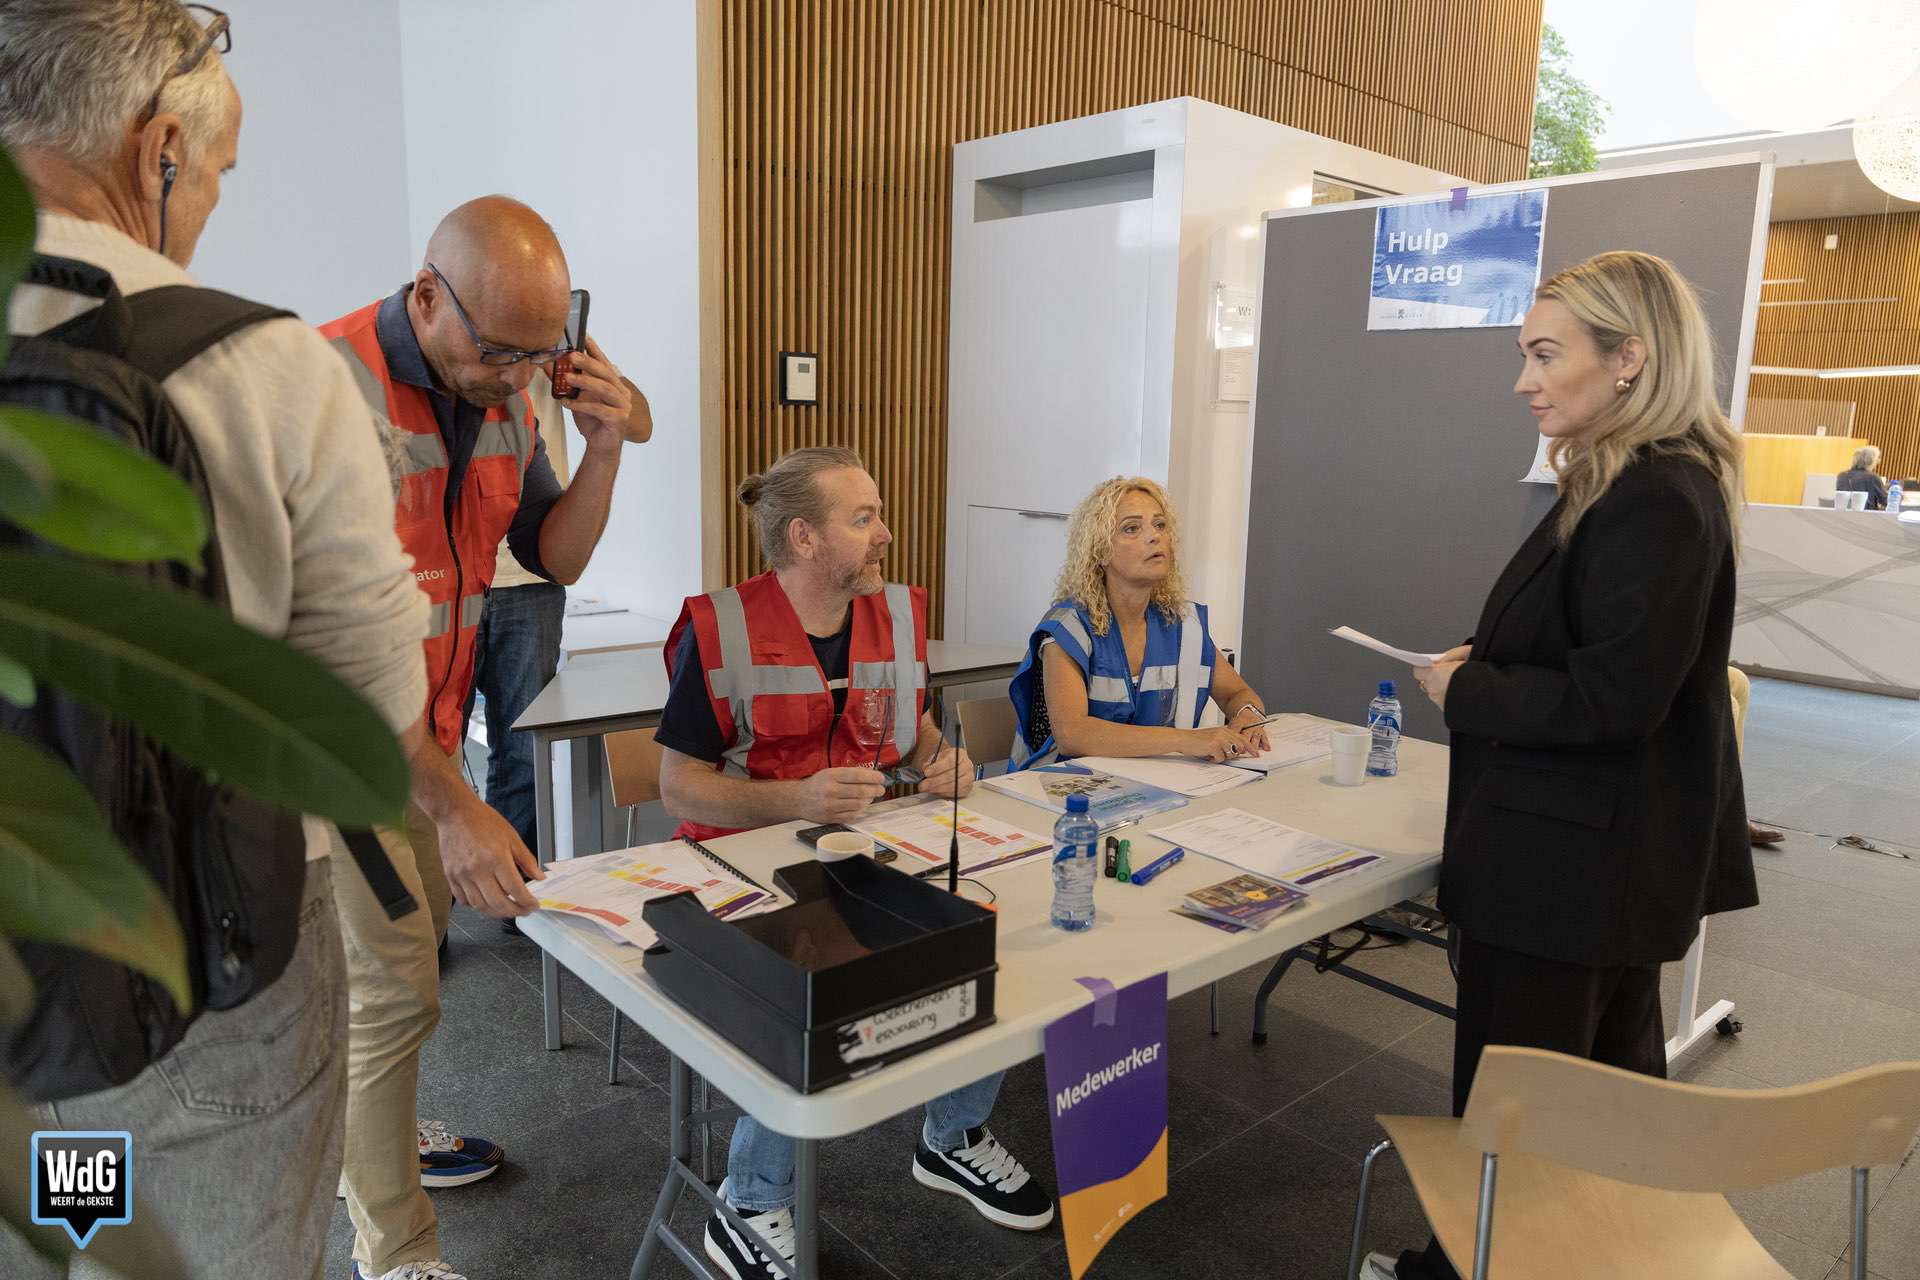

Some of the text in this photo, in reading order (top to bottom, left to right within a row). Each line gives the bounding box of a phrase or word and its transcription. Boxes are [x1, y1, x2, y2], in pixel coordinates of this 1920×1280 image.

[1388, 228, 1449, 255] Hulp
[1385, 263, 1463, 287] Vraag
[1056, 1042, 1161, 1117] Medewerker
